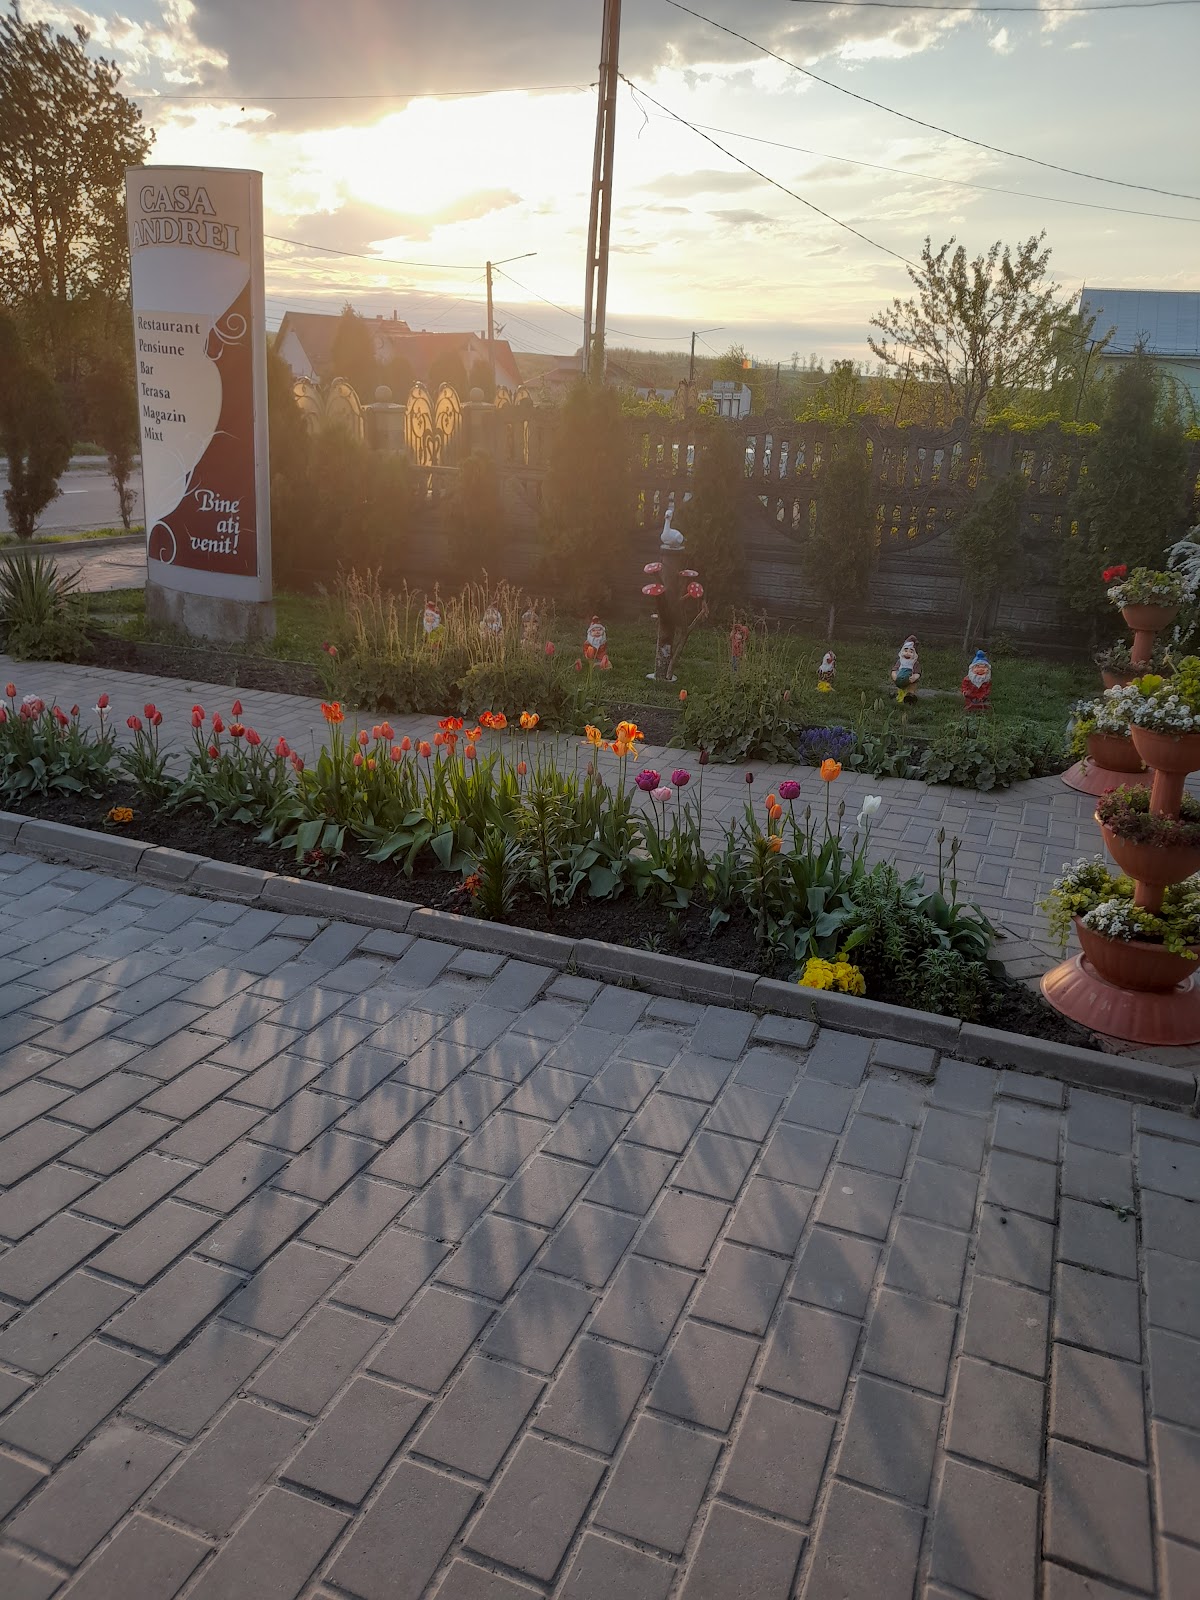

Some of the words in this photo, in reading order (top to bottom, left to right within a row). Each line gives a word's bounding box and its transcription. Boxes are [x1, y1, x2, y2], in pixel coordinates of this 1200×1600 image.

[139, 185, 216, 216] CASA
[133, 216, 239, 256] ANDREI
[137, 316, 200, 334] Restaurant
[139, 339, 185, 356] Pensiune
[140, 361, 154, 375] Bar
[141, 382, 171, 399] Terasa
[143, 404, 186, 424] Magazin
[144, 426, 164, 441] Mixt
[194, 489, 240, 513] Bine
[190, 535, 239, 555] venit!
